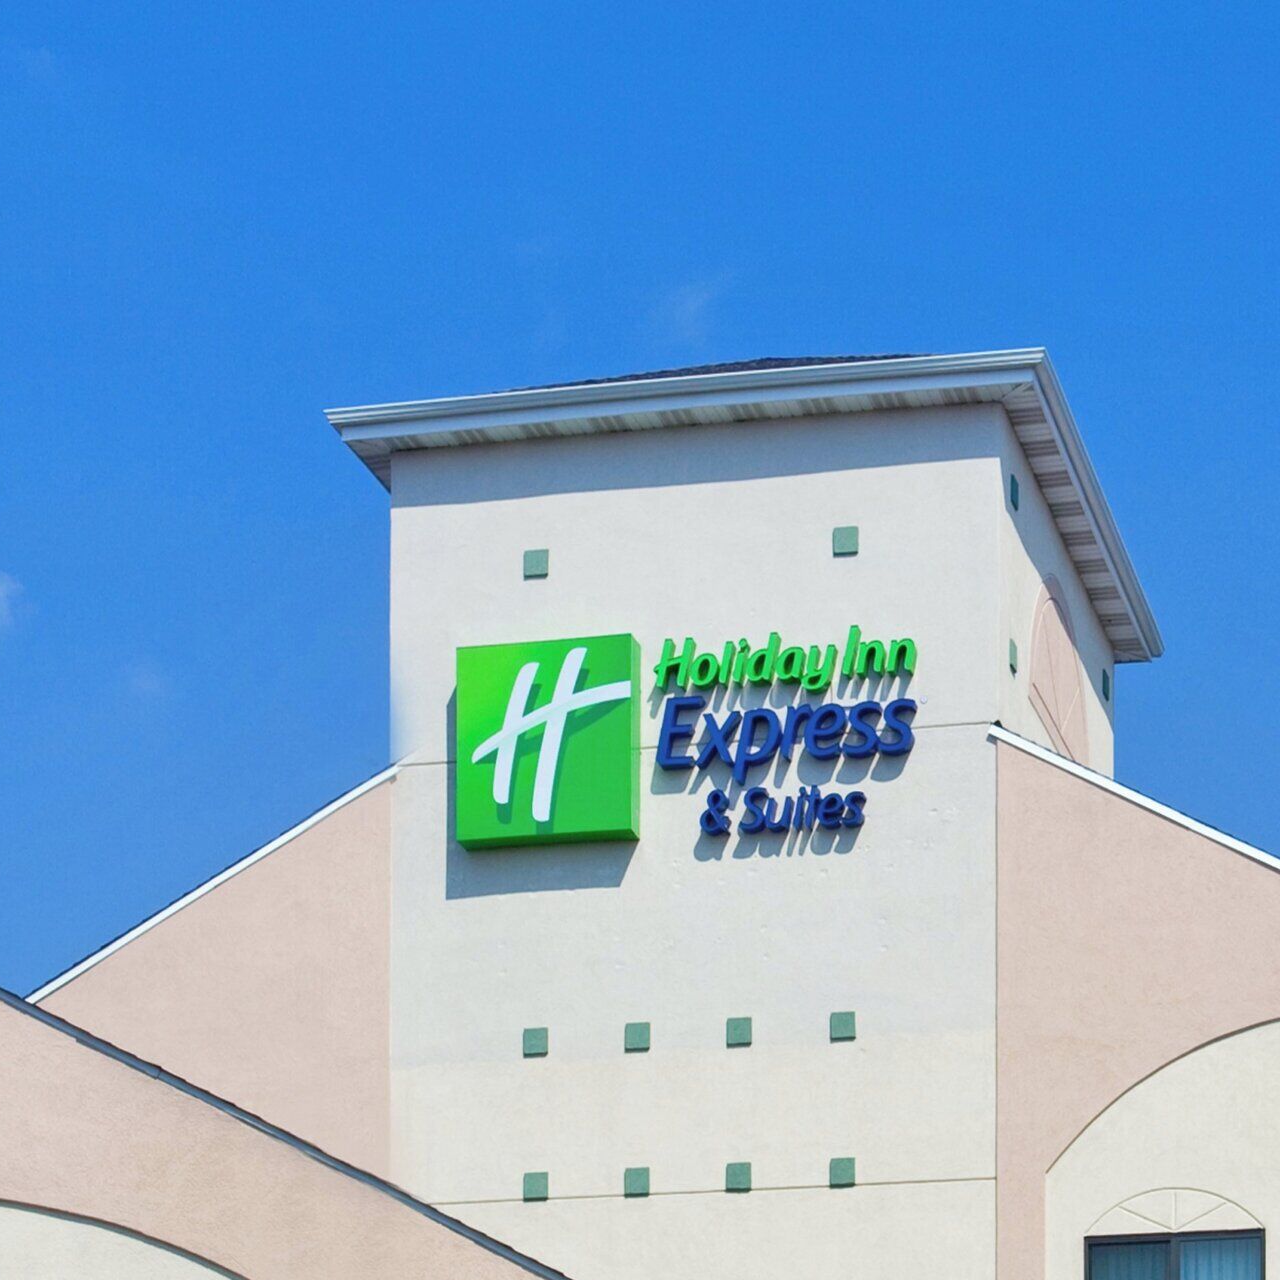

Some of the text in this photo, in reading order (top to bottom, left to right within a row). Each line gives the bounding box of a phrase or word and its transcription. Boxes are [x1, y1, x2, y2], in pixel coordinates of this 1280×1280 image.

[654, 625, 917, 694] Holiday Inn
[471, 646, 632, 823] H
[656, 695, 917, 786] Express
[699, 785, 867, 836] & Suites
